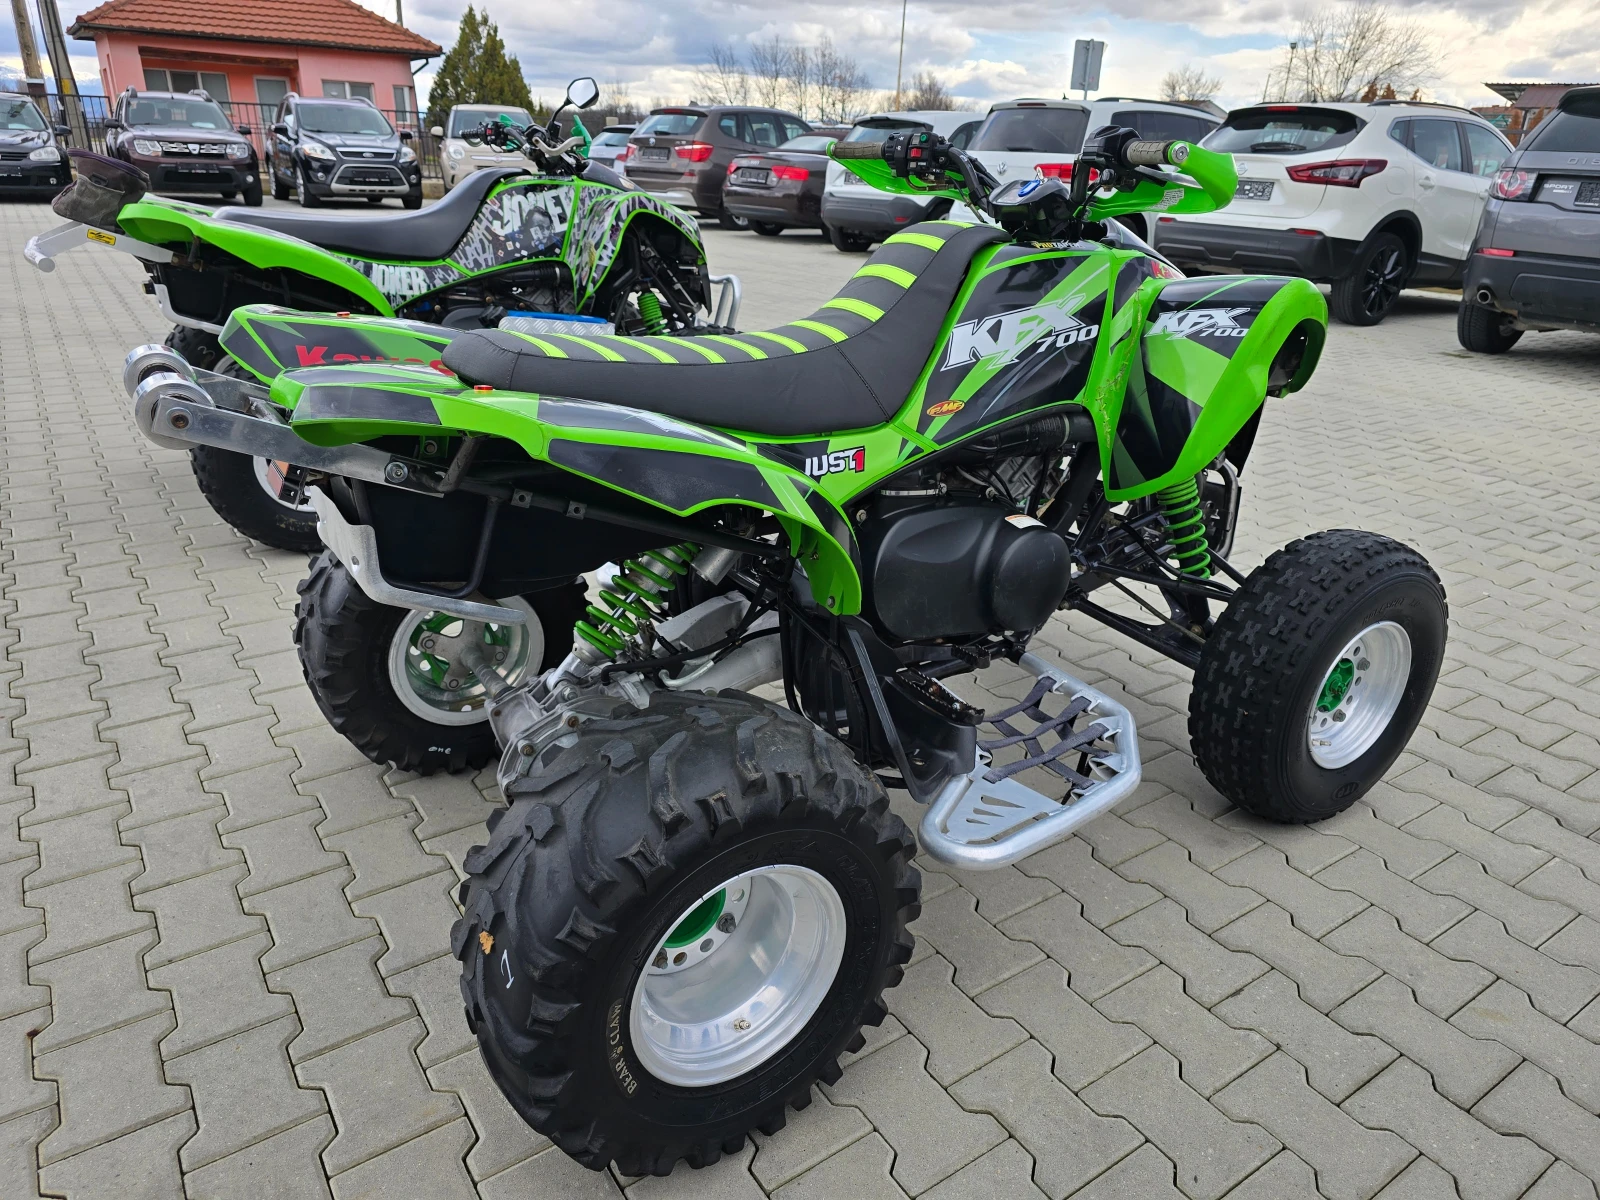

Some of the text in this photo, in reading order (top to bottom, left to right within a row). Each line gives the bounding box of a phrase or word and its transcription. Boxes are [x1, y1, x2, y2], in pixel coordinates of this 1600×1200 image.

[940, 293, 1099, 372] KFX 700
[1144, 308, 1251, 340] KFX 700
[929, 401, 964, 415] FMF
[610, 1004, 637, 1094] BEAR CLAW
